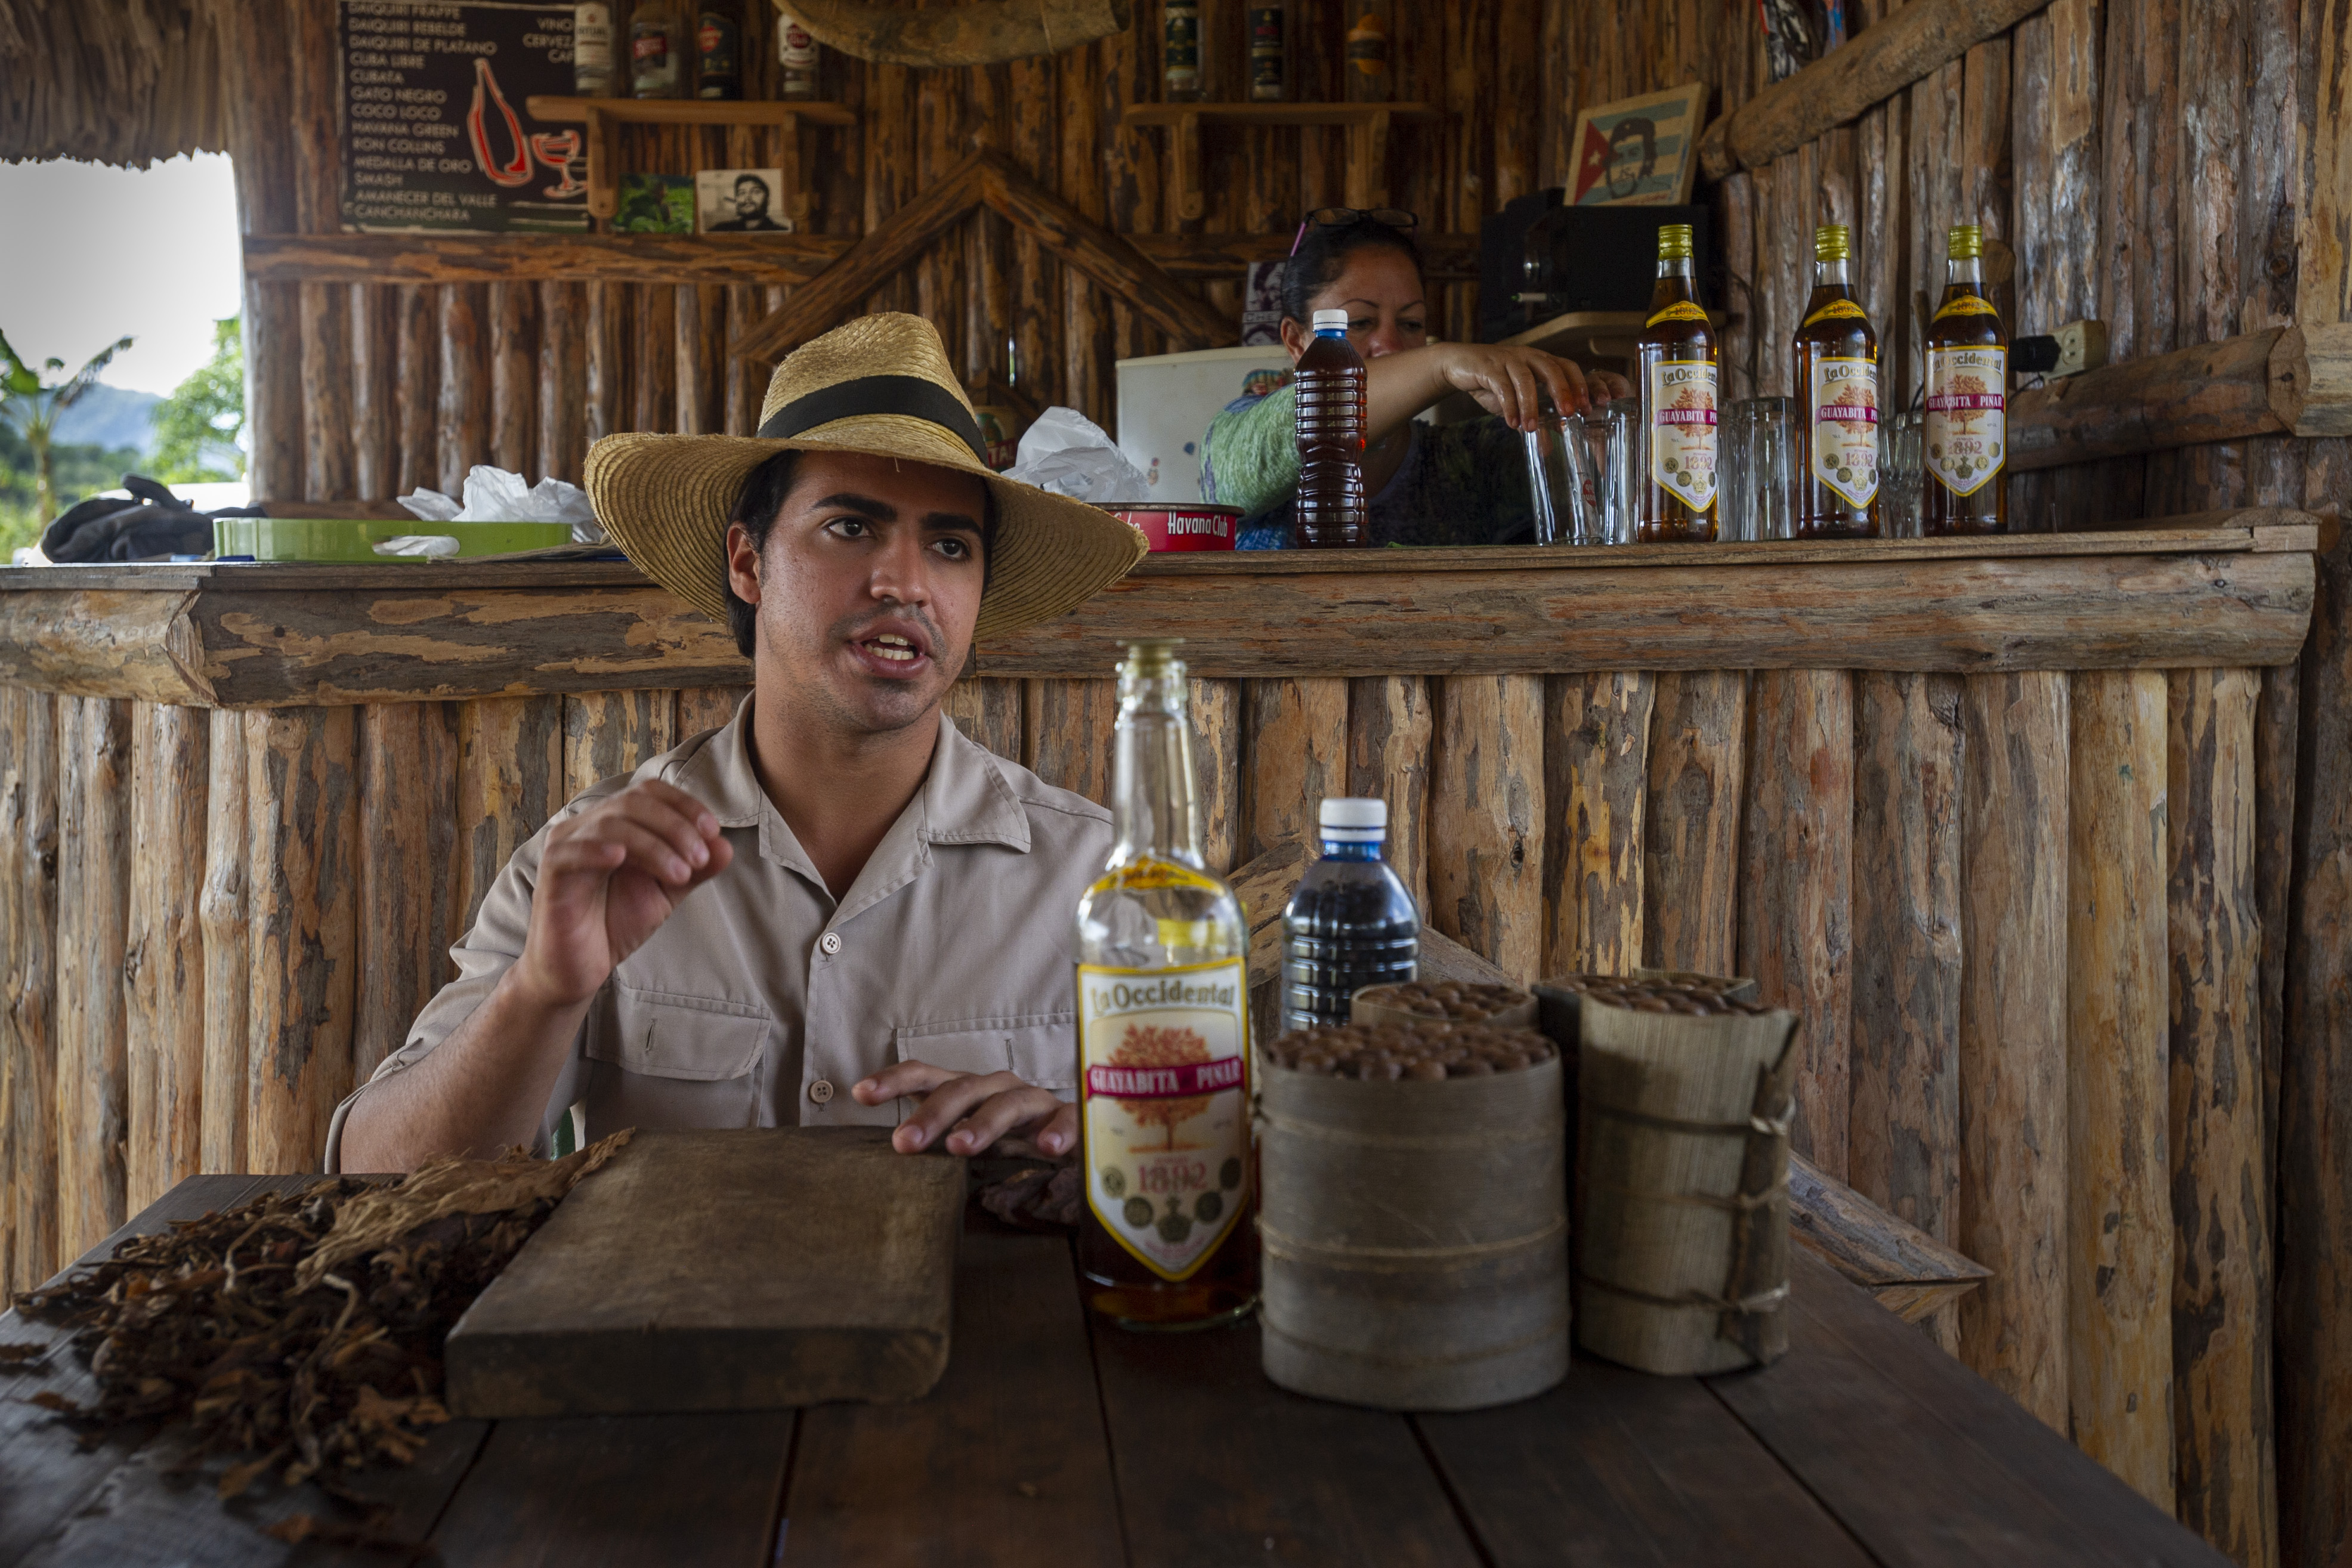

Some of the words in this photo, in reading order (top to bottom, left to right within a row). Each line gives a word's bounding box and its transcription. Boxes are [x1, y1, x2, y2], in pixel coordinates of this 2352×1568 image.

[348, 17, 410, 33] DAIQUIRI
[412, 20, 466, 37] REBELDE
[349, 34, 410, 50] DAIQUIRI
[412, 37, 431, 52] DE
[433, 38, 497, 55] PLATANO
[349, 51, 388, 67] CUBA
[390, 54, 425, 69] LIBRE
[351, 85, 394, 101] GATO
[394, 88, 447, 104] NEGRO
[351, 103, 397, 118] COCO
[400, 105, 442, 121] LOCO
[351, 120, 410, 135] HAVANA
[412, 122, 459, 138] GREEN
[352, 136, 386, 151] RON
[388, 138, 446, 155] COLLINS
[354, 155, 416, 171] MEDALLA
[418, 157, 436, 172] DE
[438, 158, 472, 174] ORO
[356, 190, 429, 205] AMANECER
[431, 191, 455, 206] DEL
[458, 193, 497, 208] VALLE
[1940, 352, 2001, 370] Occidental
[1662, 370, 1675, 386] La
[1824, 367, 1838, 382] La
[1928, 395, 1971, 409] GUAYABITA
[1980, 395, 2002, 407] PINAR
[1659, 410, 1705, 422] GUAYABITA
[1821, 406, 1866, 419] GUAYABITA
[1948, 441, 1982, 454] 1892
[1685, 456, 1712, 470] 1892
[1846, 452, 1873, 467] 1892
[1167, 511, 1211, 534] Havana
[1212, 515, 1228, 537] Club
[1112, 979, 1235, 1009] Occidental
[1090, 1068, 1180, 1094] GUAYABITA
[1196, 1059, 1242, 1090] PINAR
[1138, 1163, 1207, 1193] 1892
